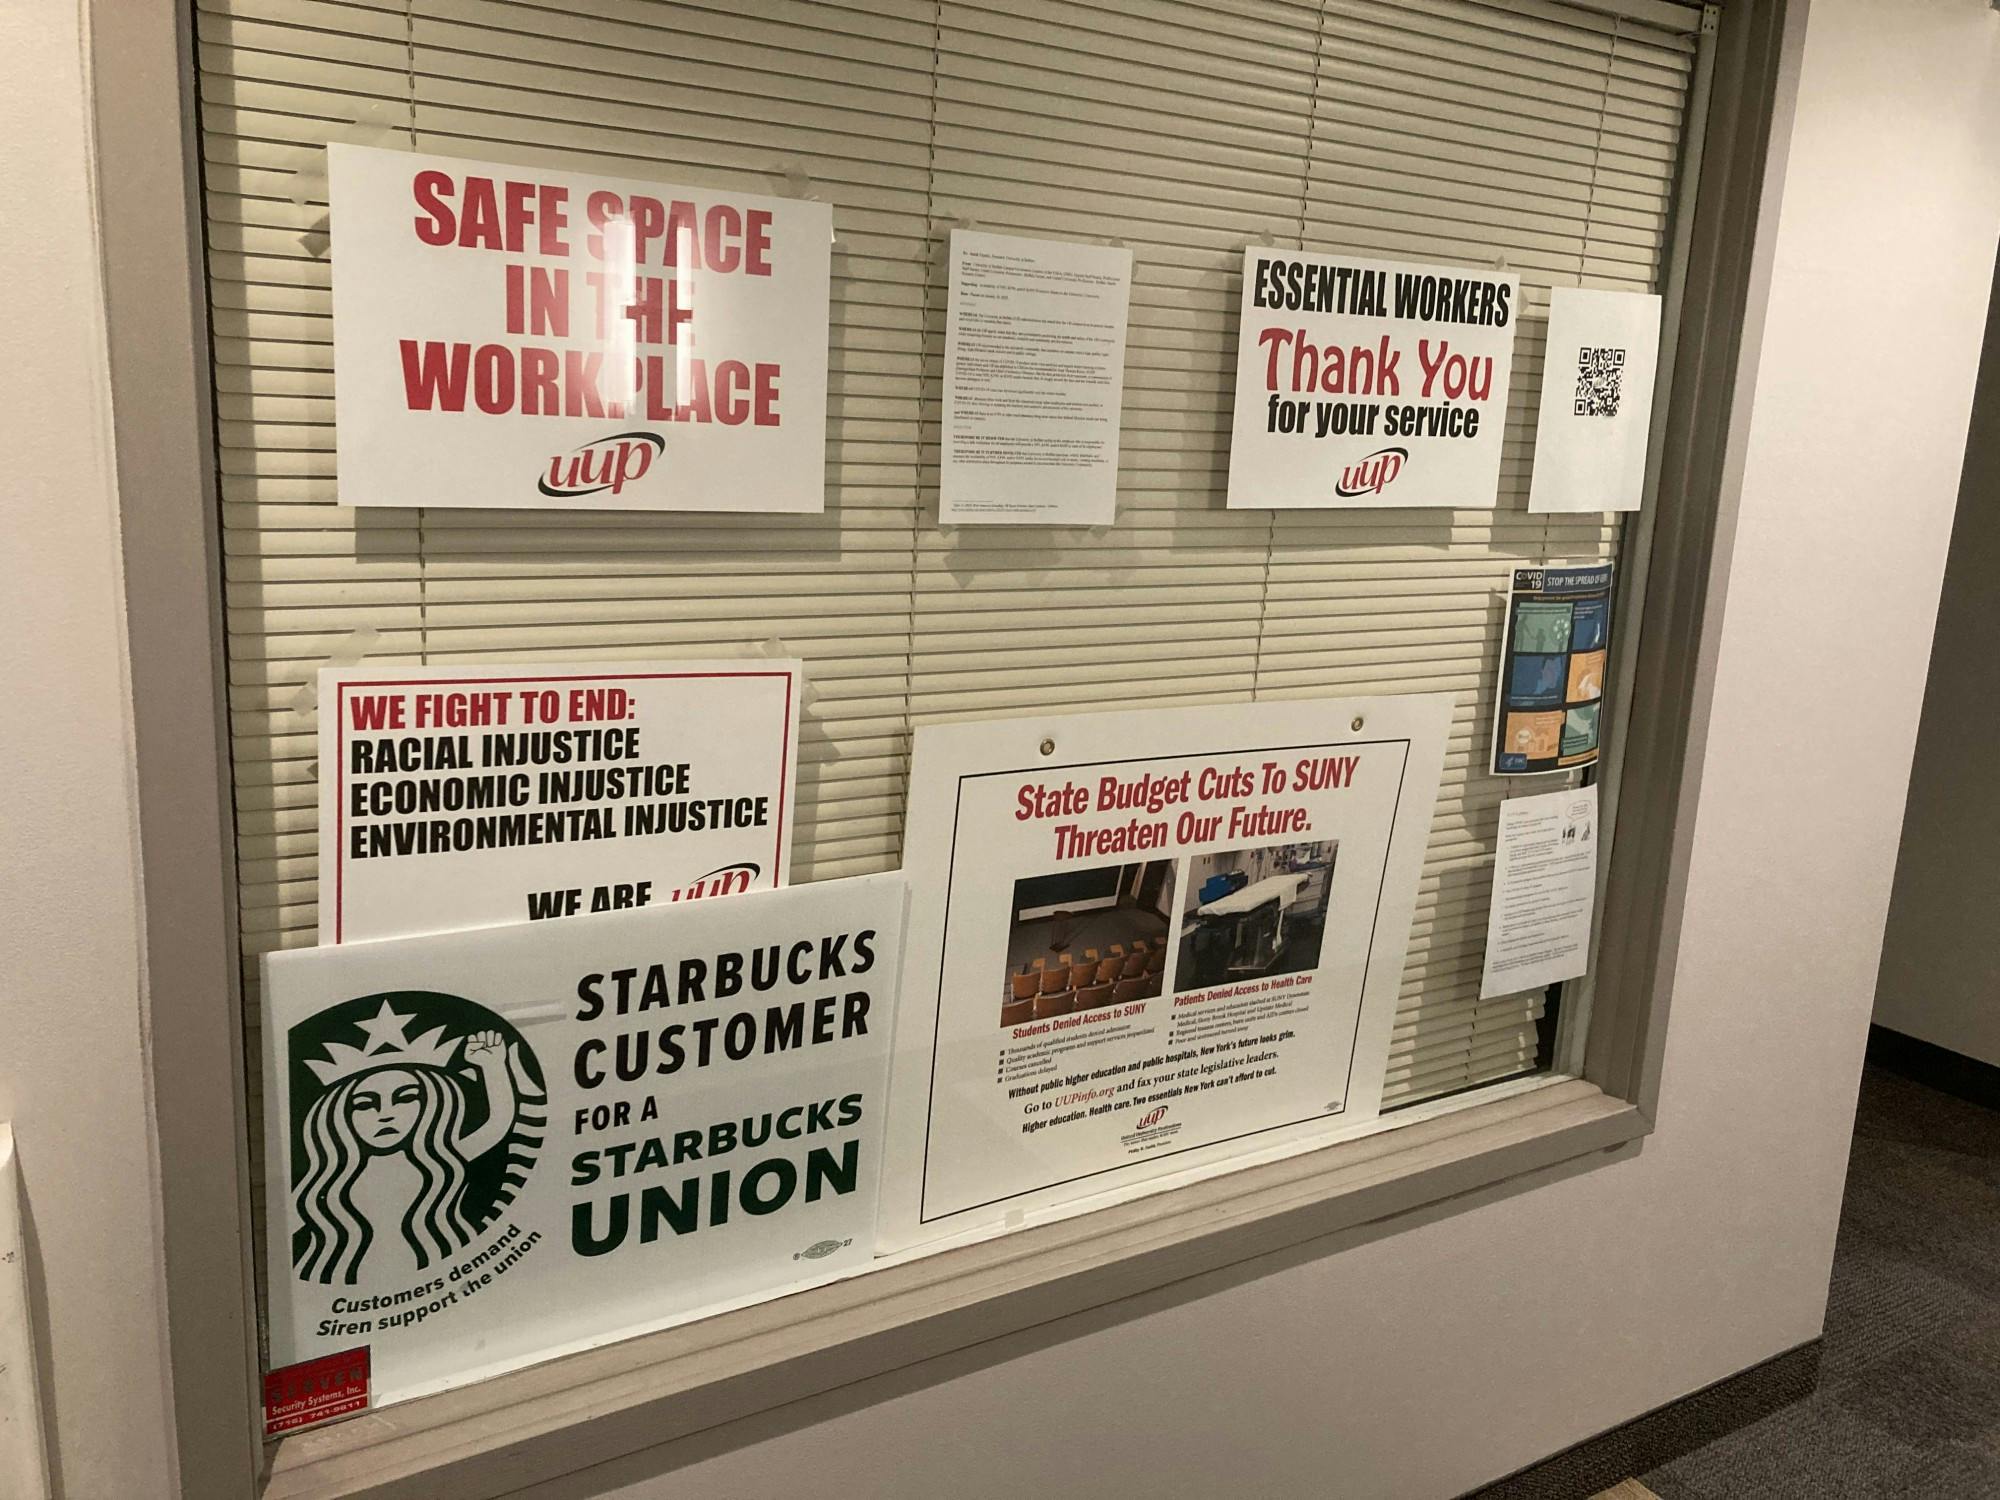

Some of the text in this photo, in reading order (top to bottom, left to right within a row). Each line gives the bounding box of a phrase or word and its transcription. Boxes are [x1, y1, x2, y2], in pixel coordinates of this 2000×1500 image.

[413, 170, 772, 277] SAFE SPACE
[505, 264, 696, 347] IN THE
[1253, 259, 1511, 328] ESSENTIAL WORKERS
[1258, 327, 1493, 401] Thank You
[1267, 393, 1479, 438] for your service
[547, 438, 654, 495] uup
[1340, 452, 1403, 495] uup
[1515, 571, 1543, 589] COVID 19
[1547, 576, 1563, 586] STOP
[1564, 575, 1575, 586] THE
[1575, 574, 1594, 585] SPREAD
[351, 688, 635, 730] WE FIGHT TO END:
[351, 728, 640, 774] RACIAL INJUSTICE
[351, 764, 690, 817] ECONOMIC INJUSTICE
[1014, 756, 1360, 821] State Budget Cuts To SUNY
[351, 797, 769, 859] ENVIRONMENTAL INJUSTICE
[1054, 805, 1312, 860] Threaten Our Future.
[527, 890, 582, 921] WE
[576, 930, 876, 1022] STARBUCKS
[1174, 975, 1313, 1007] Patients Denied Access to Health Care
[574, 991, 871, 1089] CUSTOMER
[1012, 1003, 1146, 1039] Students Denied Access to SUNY
[1006, 1054, 1026, 1066] Quality
[1008, 1029, 1295, 1099] Without public higher education and public hospitals, New York's future looks grim.
[1024, 1050, 1280, 1114] Go to UUPinfo.org and fax your state legislative leaders.
[574, 1096, 659, 1135] FOR A
[1022, 1066, 1277, 1134] Higher education. Health care. Two essentials New York can't afford to cut.
[571, 1093, 863, 1186] STARBUCKS
[572, 1139, 860, 1257] UNION
[331, 1224, 521, 1314] Customers demand
[843, 1238, 853, 1246] 27
[316, 1230, 543, 1337] Siren support the union
[272, 1385, 361, 1415] Security Systems, Inc.
